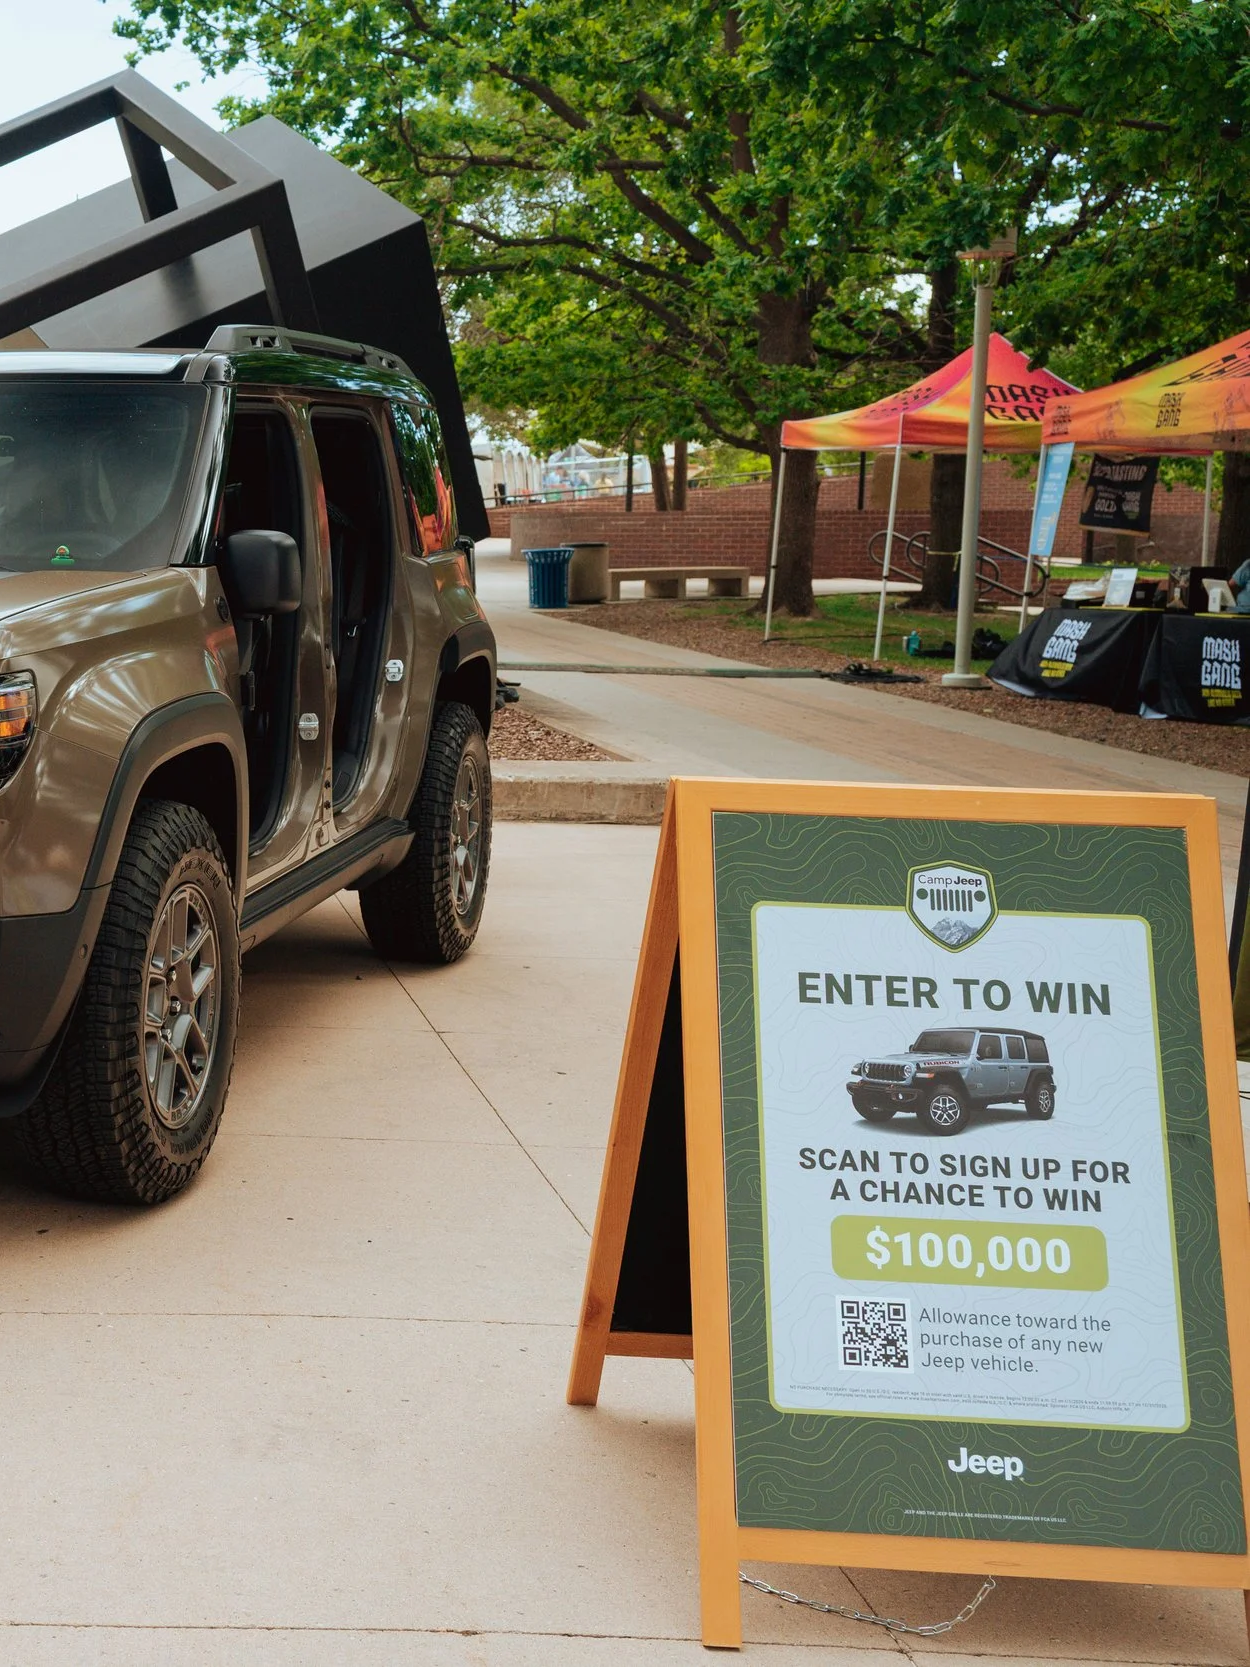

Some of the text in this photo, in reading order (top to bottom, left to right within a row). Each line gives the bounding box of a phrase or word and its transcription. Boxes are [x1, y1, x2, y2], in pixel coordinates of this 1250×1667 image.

[1156, 408, 1181, 428] GANG
[1053, 618, 1092, 640] MASH
[1042, 636, 1079, 663] GANG
[1202, 636, 1241, 662] MASH
[1201, 660, 1242, 690] GANG
[797, 971, 1111, 1016] ENTER TO WIN
[799, 1147, 1131, 1184] SCAN TO SIGN UP FOR
[830, 1179, 1102, 1213] A CHANCE TO WIN
[865, 1225, 1071, 1278] $100,000
[919, 1308, 1111, 1332] Allowance toward the
[920, 1331, 1103, 1356] purchase of any new
[921, 1353, 1039, 1373] Jeep vehicle.
[948, 1447, 1024, 1481] Jeep
